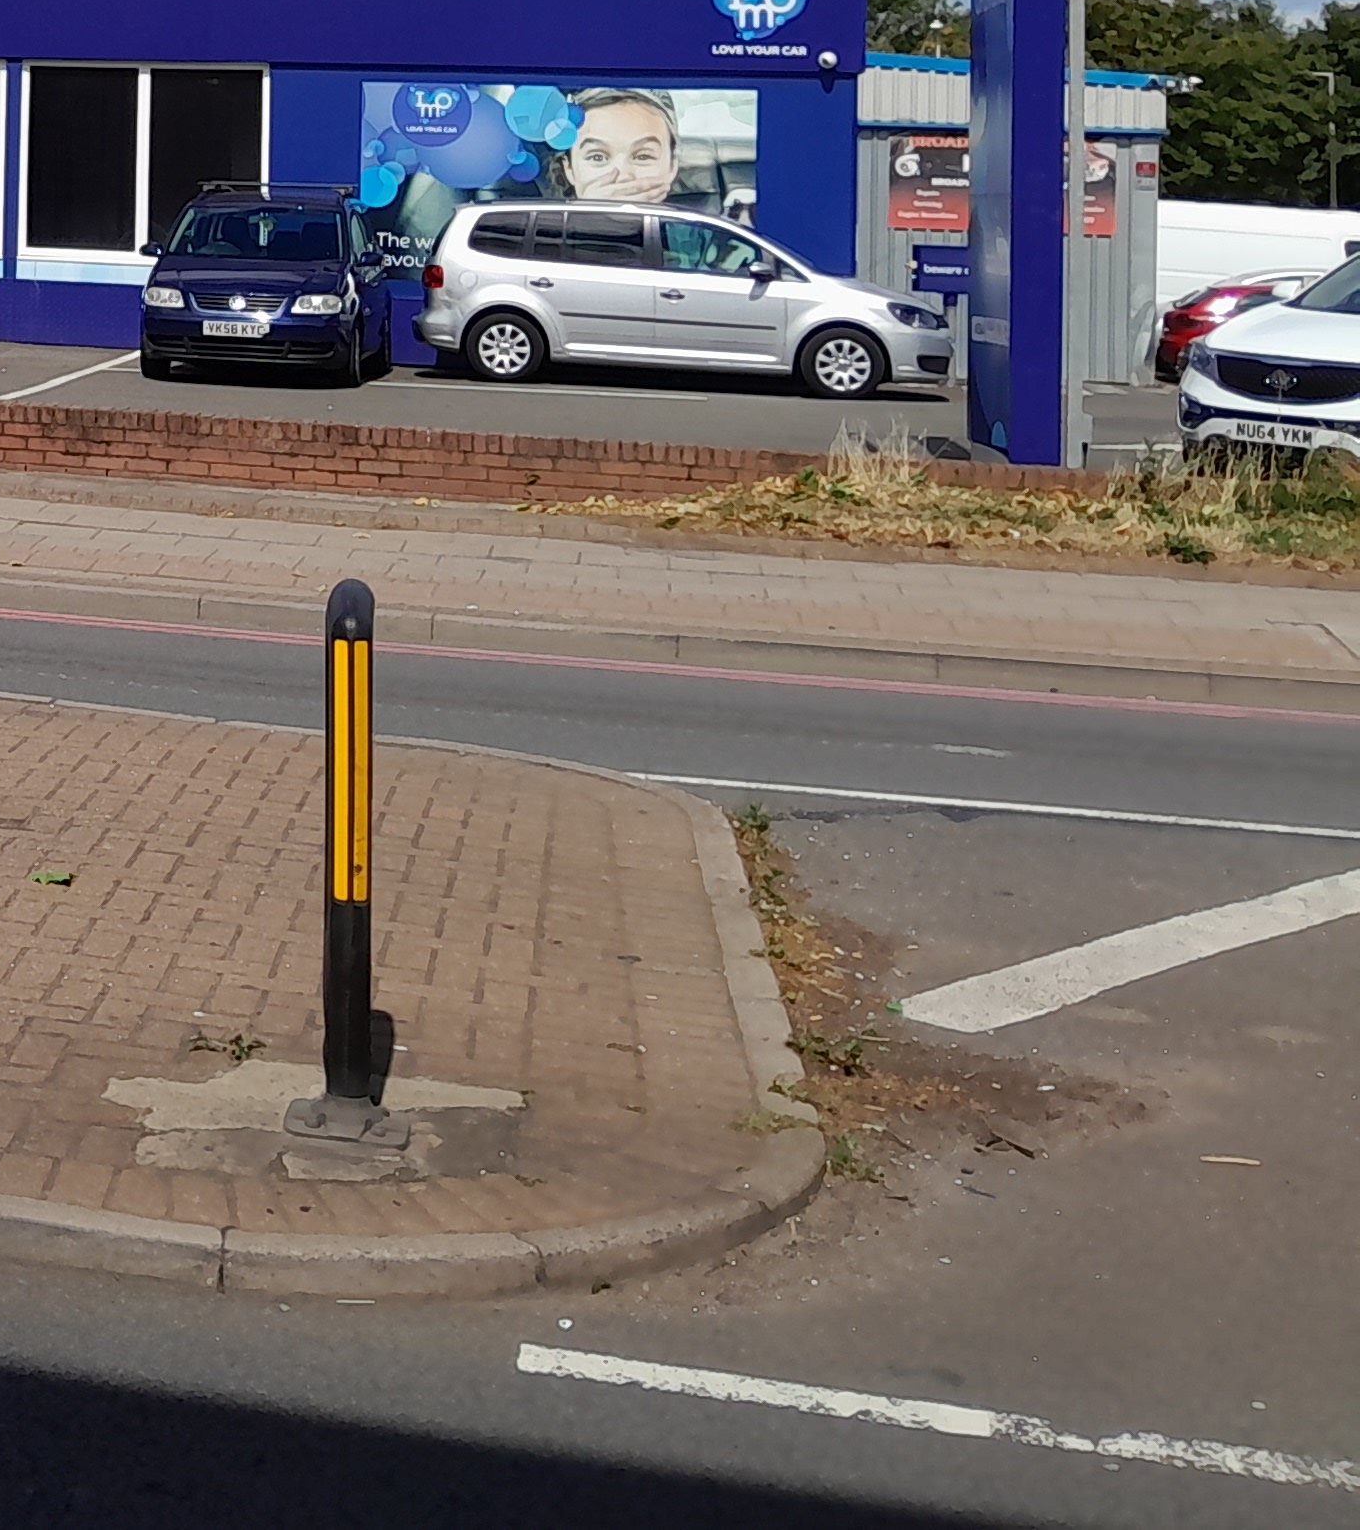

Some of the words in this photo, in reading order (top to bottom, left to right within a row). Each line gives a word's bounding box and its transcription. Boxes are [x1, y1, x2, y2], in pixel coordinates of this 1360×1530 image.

[712, 44, 744, 55] LOVE
[745, 45, 780, 56] YOUR
[781, 45, 808, 56] CAR
[376, 232, 410, 249] The
[1236, 422, 1275, 440] NU64
